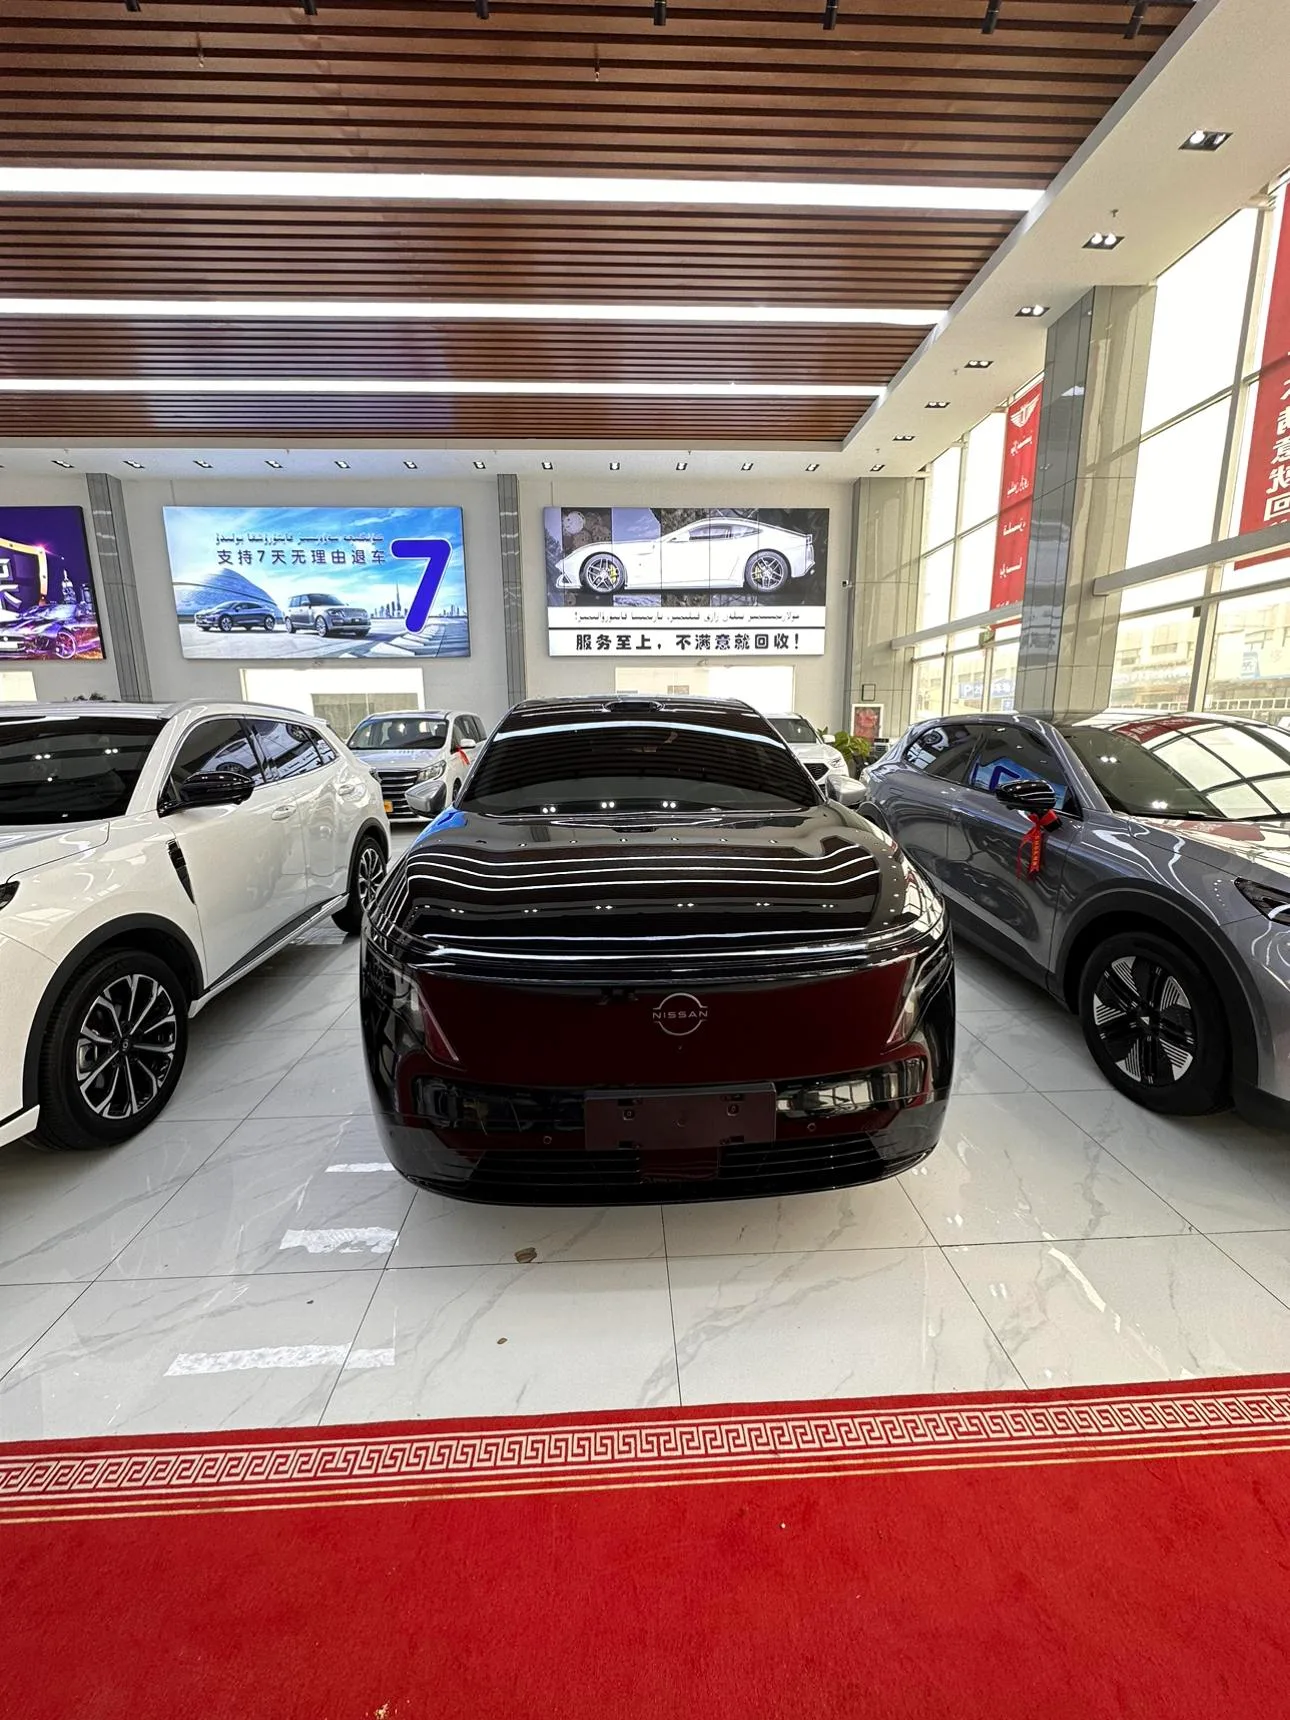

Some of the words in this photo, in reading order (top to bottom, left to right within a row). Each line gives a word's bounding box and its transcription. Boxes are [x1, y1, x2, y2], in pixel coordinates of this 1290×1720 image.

[217, 548, 386, 565] 支持7天无理由退车
[652, 1010, 709, 1020] NISSAN
